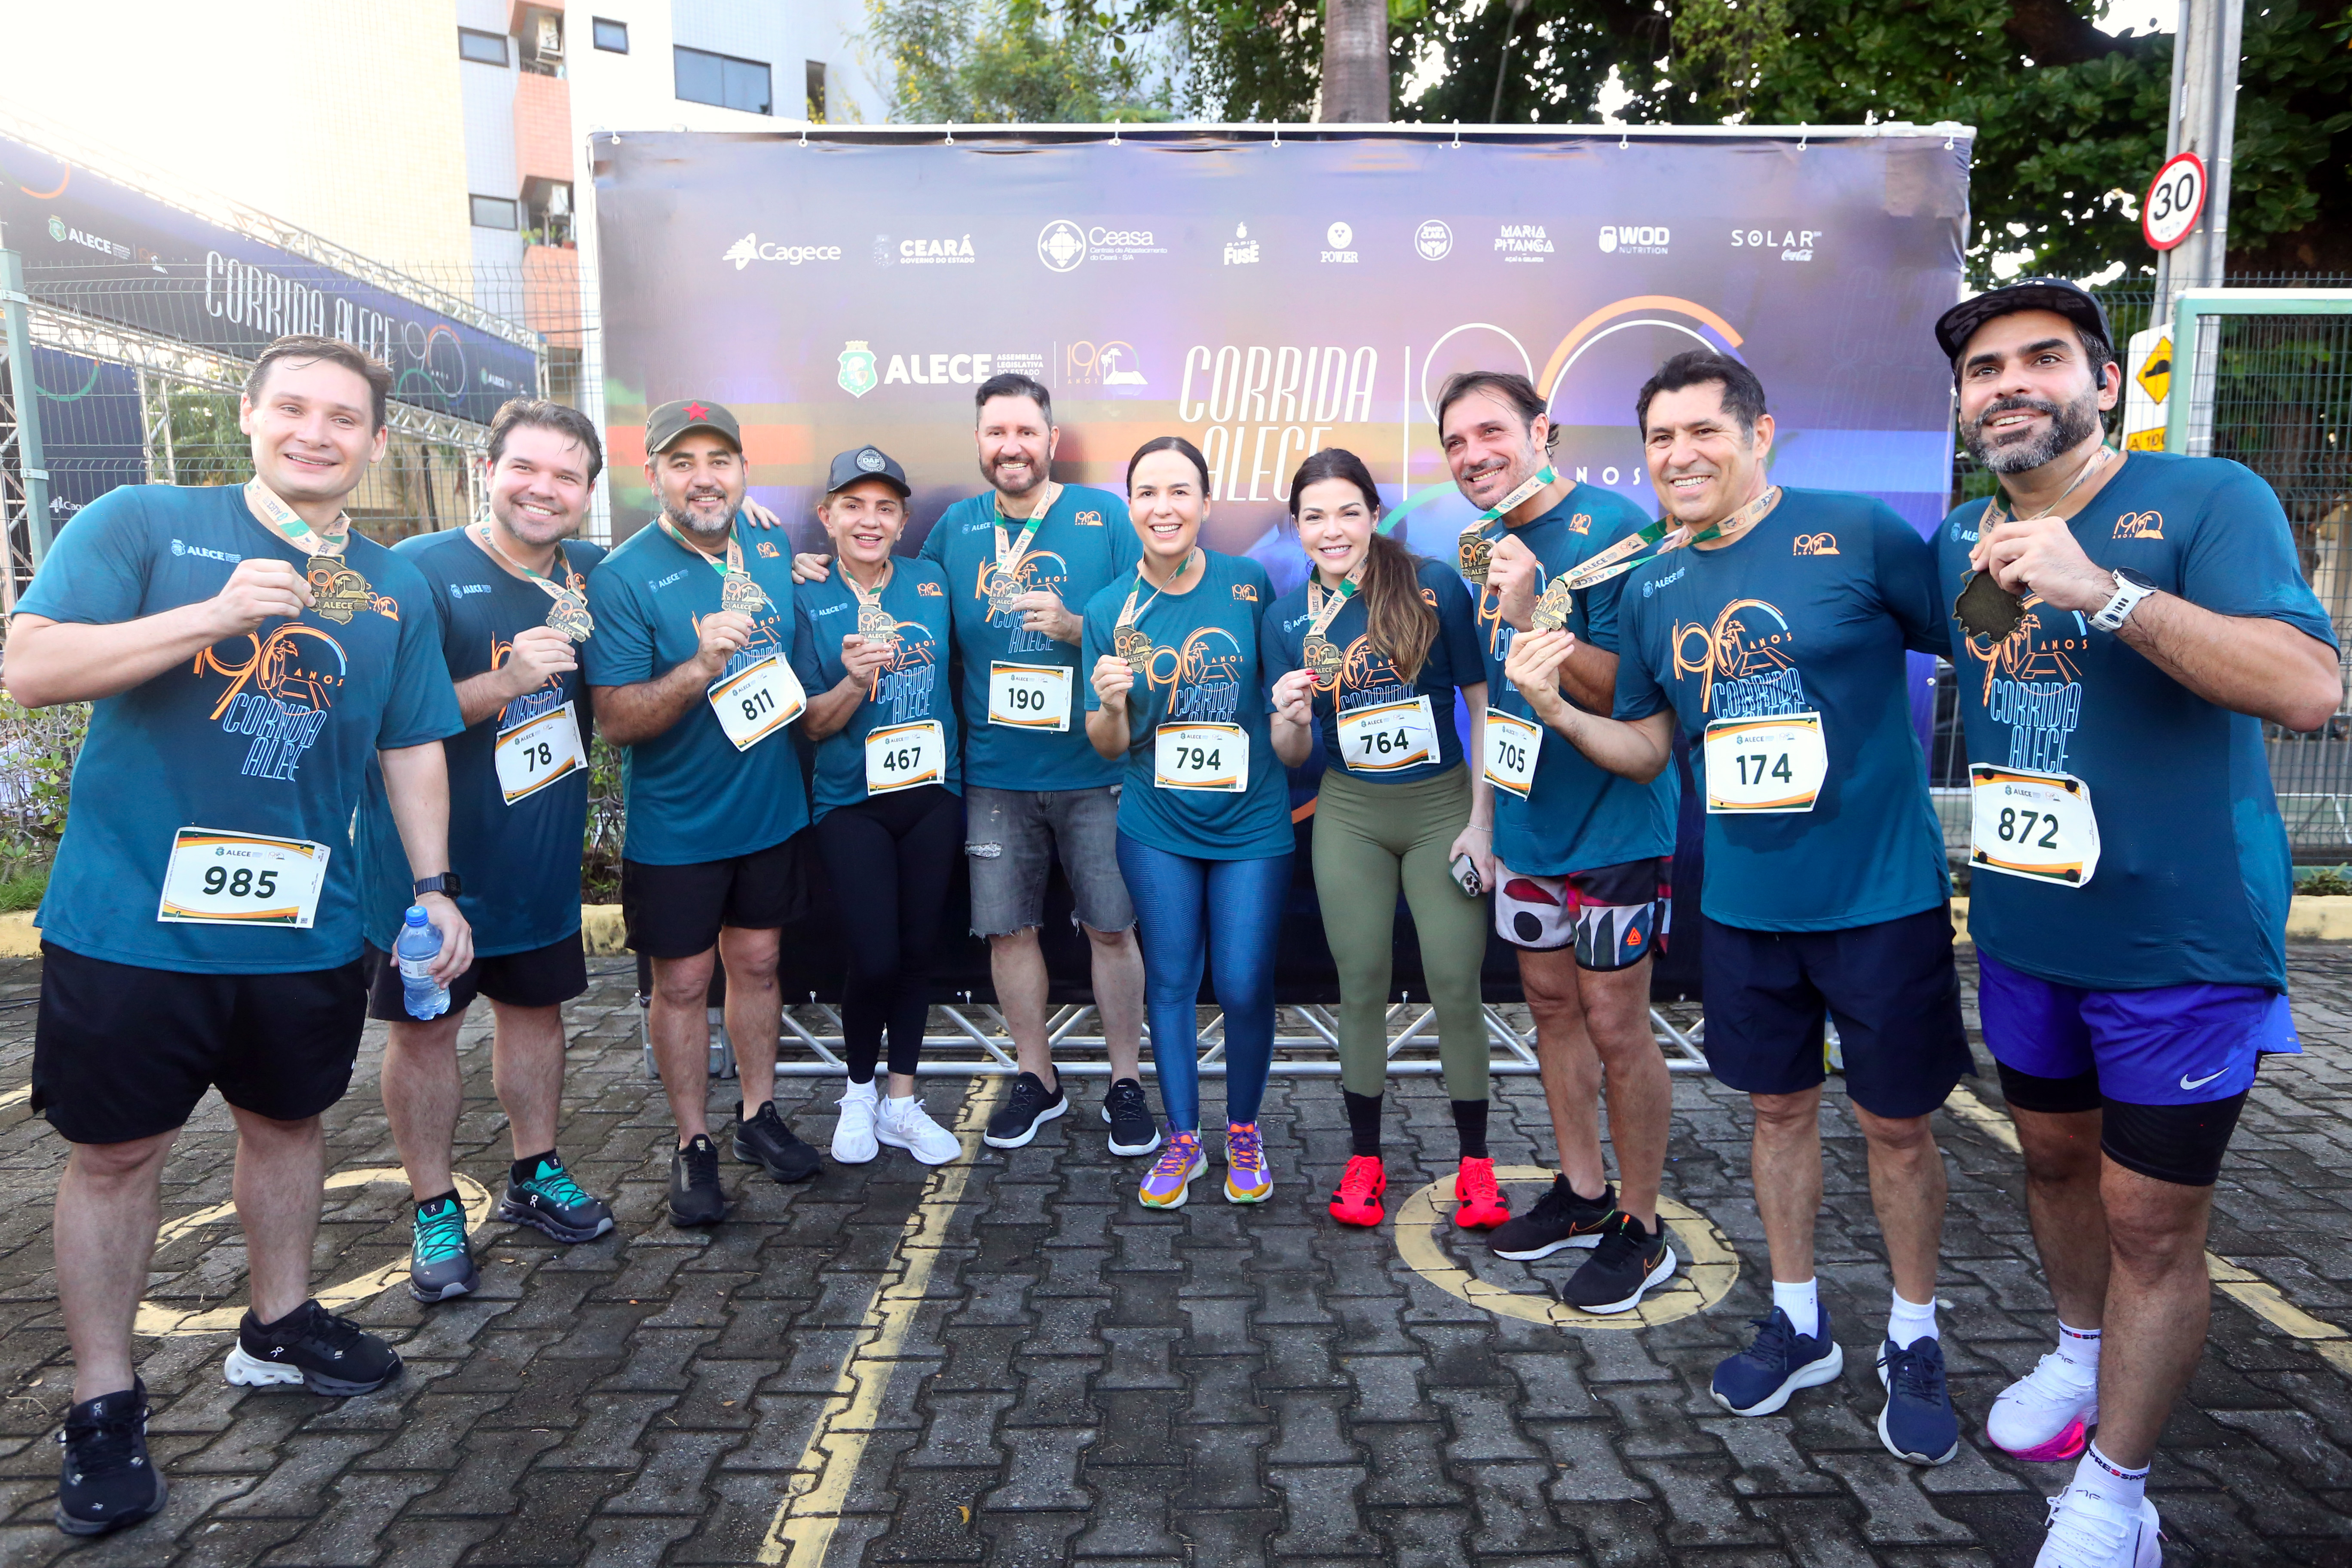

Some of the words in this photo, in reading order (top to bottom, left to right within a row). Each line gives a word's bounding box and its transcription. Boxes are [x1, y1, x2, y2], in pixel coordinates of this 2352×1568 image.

[2154, 173, 2194, 221] 30
[69, 227, 112, 254] ALECE
[1089, 227, 1154, 246] Ceasa
[1501, 225, 1547, 239] MARIA
[1618, 227, 1670, 245] WOD
[1730, 230, 1813, 247] SOLAR
[900, 233, 975, 257] CEARÁ
[1494, 239, 1555, 253] PITANGA
[759, 242, 842, 266] Cagece
[1224, 244, 1260, 266] FUSE
[1320, 251, 1359, 263] POWER
[206, 251, 325, 337] CORRIDA
[883, 354, 992, 384] ALECE
[1179, 346, 1378, 423] CORRIDA
[1508, 494, 1522, 505] ALECE
[266, 500, 284, 517] ALECE
[971, 522, 991, 531] ALECE
[2113, 510, 2163, 535] 190
[1016, 540, 1026, 553] ALECE
[1793, 532, 1837, 552] 190
[187, 545, 225, 560] ALECE
[1583, 557, 1608, 572] ALECE
[658, 573, 680, 588] ALECE
[1037, 576, 1068, 584] ANOS
[1575, 573, 1605, 586] ALECE
[1655, 573, 1677, 589] ALECE
[462, 585, 483, 594] ALECE
[323, 601, 353, 609] ALECE
[819, 606, 839, 616] ALECE
[1326, 602, 1338, 616] ALECE
[753, 615, 781, 629] ANOS
[1539, 615, 1555, 626] ALECE
[556, 623, 575, 637] ALECE
[908, 640, 935, 651] ANOS
[1750, 632, 1792, 649] ANOS
[2041, 639, 2088, 650] ANOS
[1127, 655, 1144, 664] ALECE
[1212, 655, 1243, 664] ANOS
[294, 668, 344, 687] ANOS
[876, 664, 935, 704] CORRIDA
[738, 683, 751, 693] ALECE
[1711, 668, 1806, 719] CORRIDA
[741, 688, 775, 720] 811
[892, 689, 932, 724] ALECE
[1008, 688, 1044, 710] 190
[1174, 681, 1239, 717] CORRIDA
[1990, 678, 2082, 729] CORRIDA
[521, 733, 535, 742] ALECE
[1360, 729, 1409, 754] 764
[524, 742, 552, 773] 78
[1498, 741, 1525, 773] 705
[2008, 725, 2074, 775] ALECE
[884, 747, 921, 772] 467
[1176, 747, 1221, 771] 794
[1736, 753, 1792, 785] 174
[2014, 789, 2033, 797] ALECE
[1999, 807, 2058, 849] 872
[202, 866, 279, 899] 985
